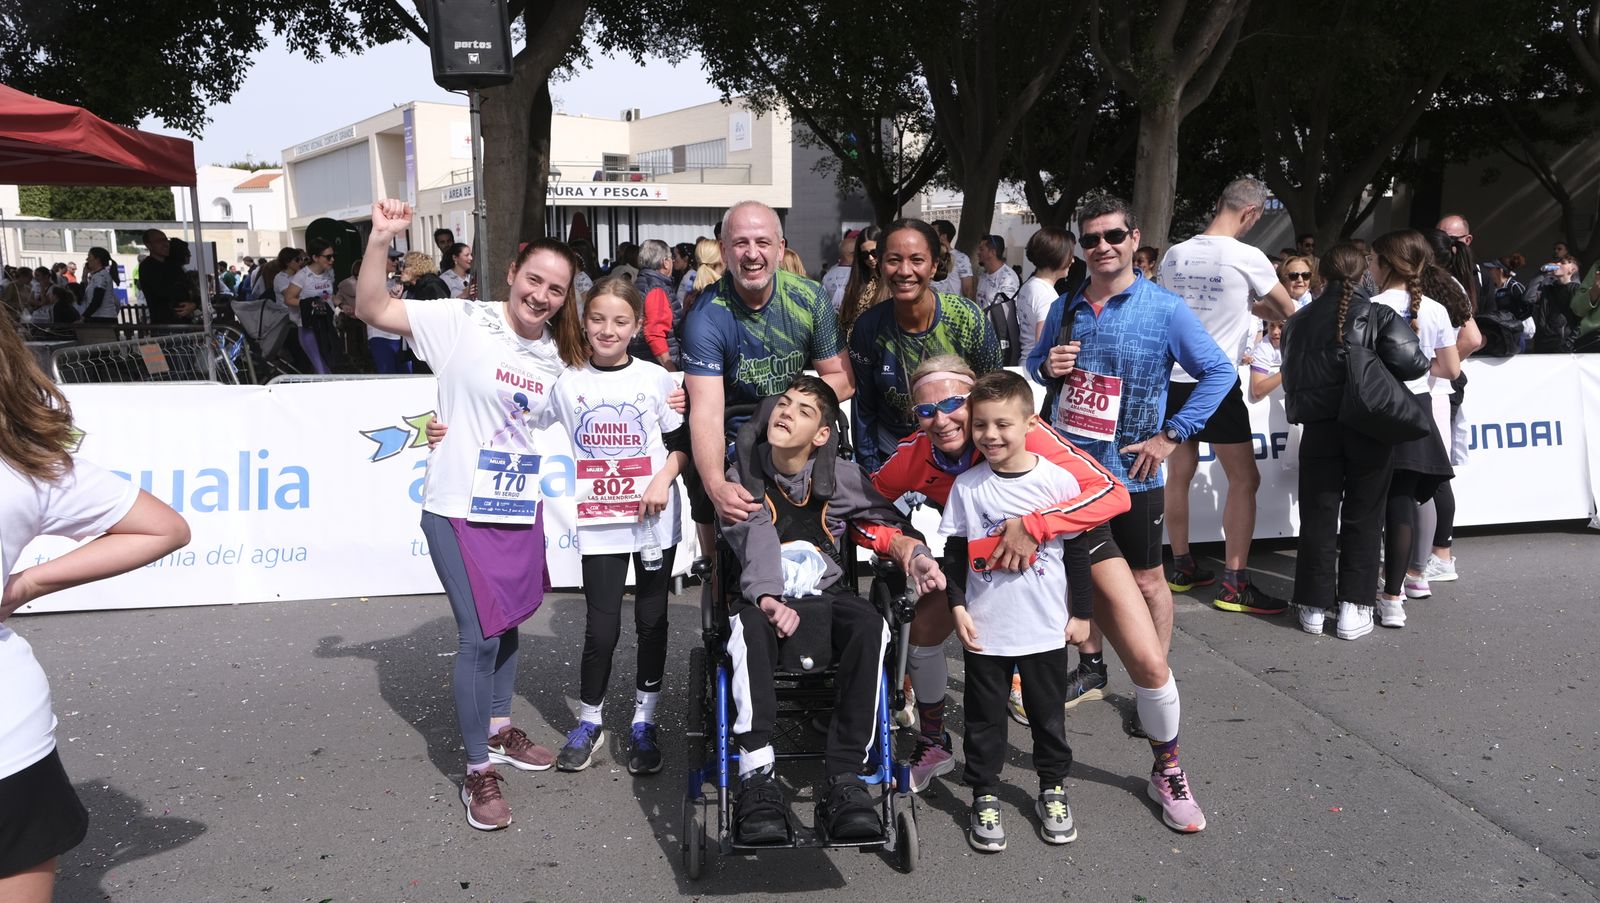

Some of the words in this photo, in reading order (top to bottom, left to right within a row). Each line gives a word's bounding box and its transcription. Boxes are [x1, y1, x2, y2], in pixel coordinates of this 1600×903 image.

[464, 187, 472, 196] DE
[589, 187, 598, 197] Y
[604, 187, 648, 197] PESCA
[496, 368, 543, 395] MUJER
[1066, 387, 1109, 412] 2540
[595, 423, 628, 434] MINI
[583, 434, 642, 446] RUNNER
[493, 472, 526, 492] 170
[593, 478, 636, 496] 802
[206, 544, 244, 566] del
[251, 546, 308, 568] agua
